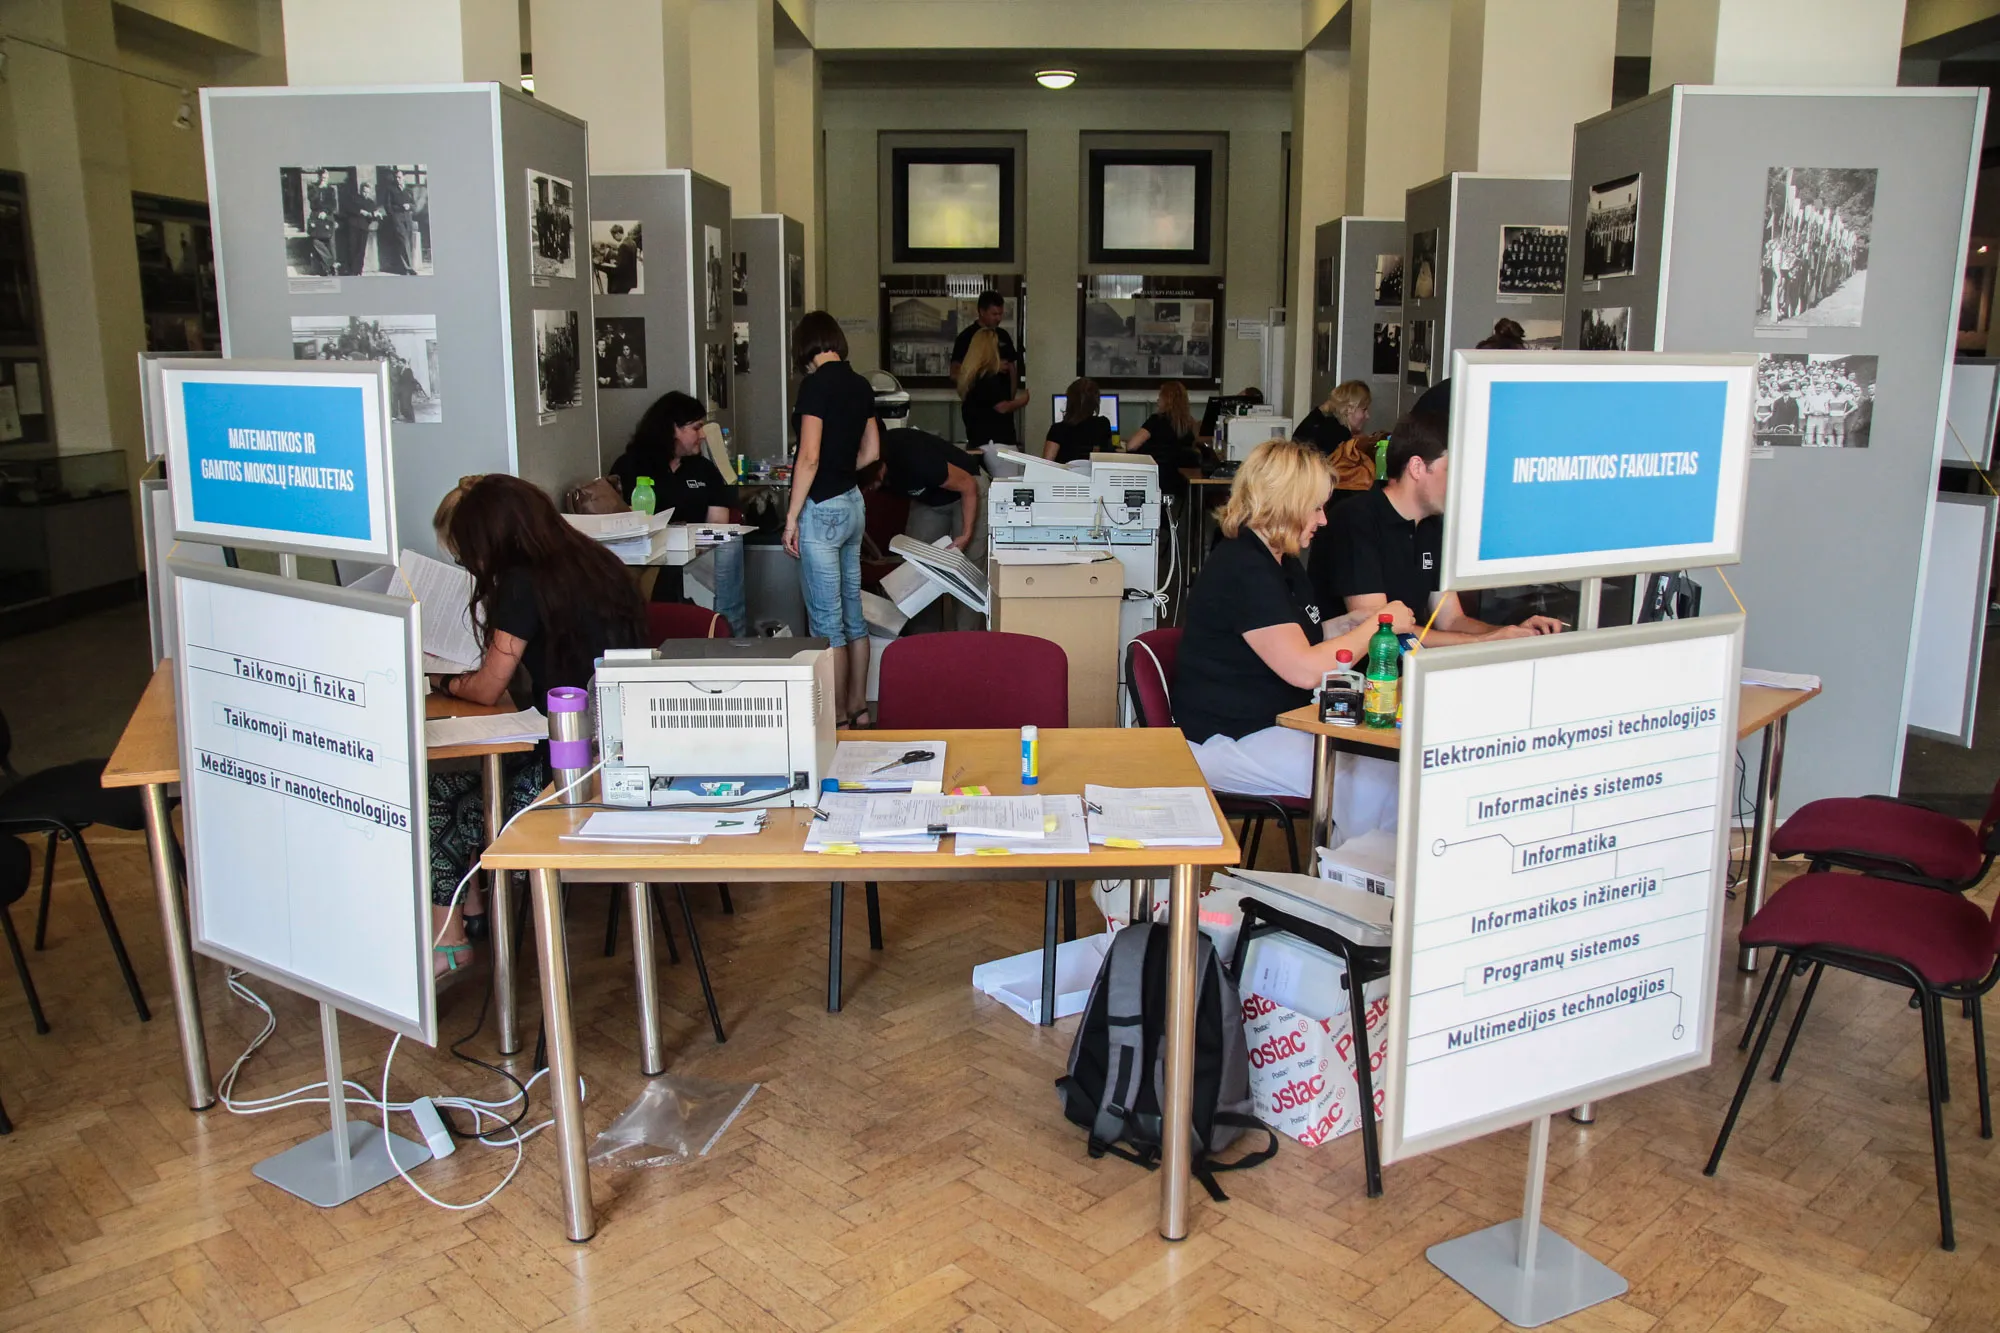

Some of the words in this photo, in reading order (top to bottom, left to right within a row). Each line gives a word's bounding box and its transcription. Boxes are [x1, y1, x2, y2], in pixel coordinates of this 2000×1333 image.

[228, 428, 302, 454] MATEMATIKOS
[303, 432, 316, 454] IR
[201, 458, 242, 482] GAMTOS
[243, 461, 287, 489] MOKSLŲ
[288, 465, 354, 491] FAKULTETAS
[1512, 454, 1618, 483] INFORMATIKOS
[1619, 451, 1699, 478] FAKULTETAS
[233, 658, 307, 693] Taikomoji
[313, 675, 356, 702] fizika
[224, 707, 287, 742] Taikomoji
[292, 728, 374, 763] matematika
[1423, 736, 1527, 769] Elektroninio
[1532, 720, 1613, 750] mokymosi
[1618, 705, 1716, 737] technologijos
[201, 753, 267, 786] Medžiagos
[270, 772, 281, 789] ir
[285, 778, 407, 828] nanotechnologijos
[1478, 783, 1588, 820] Informacinės
[1593, 770, 1663, 797] sistemos
[1522, 832, 1617, 867] Informatika
[1471, 897, 1577, 934] Informatikos
[1583, 876, 1657, 907] inžinerija
[1483, 952, 1565, 985] Programų
[1570, 932, 1641, 962] sistemos
[1447, 1007, 1556, 1050] Multimedijos
[1562, 977, 1665, 1017] technologijos
